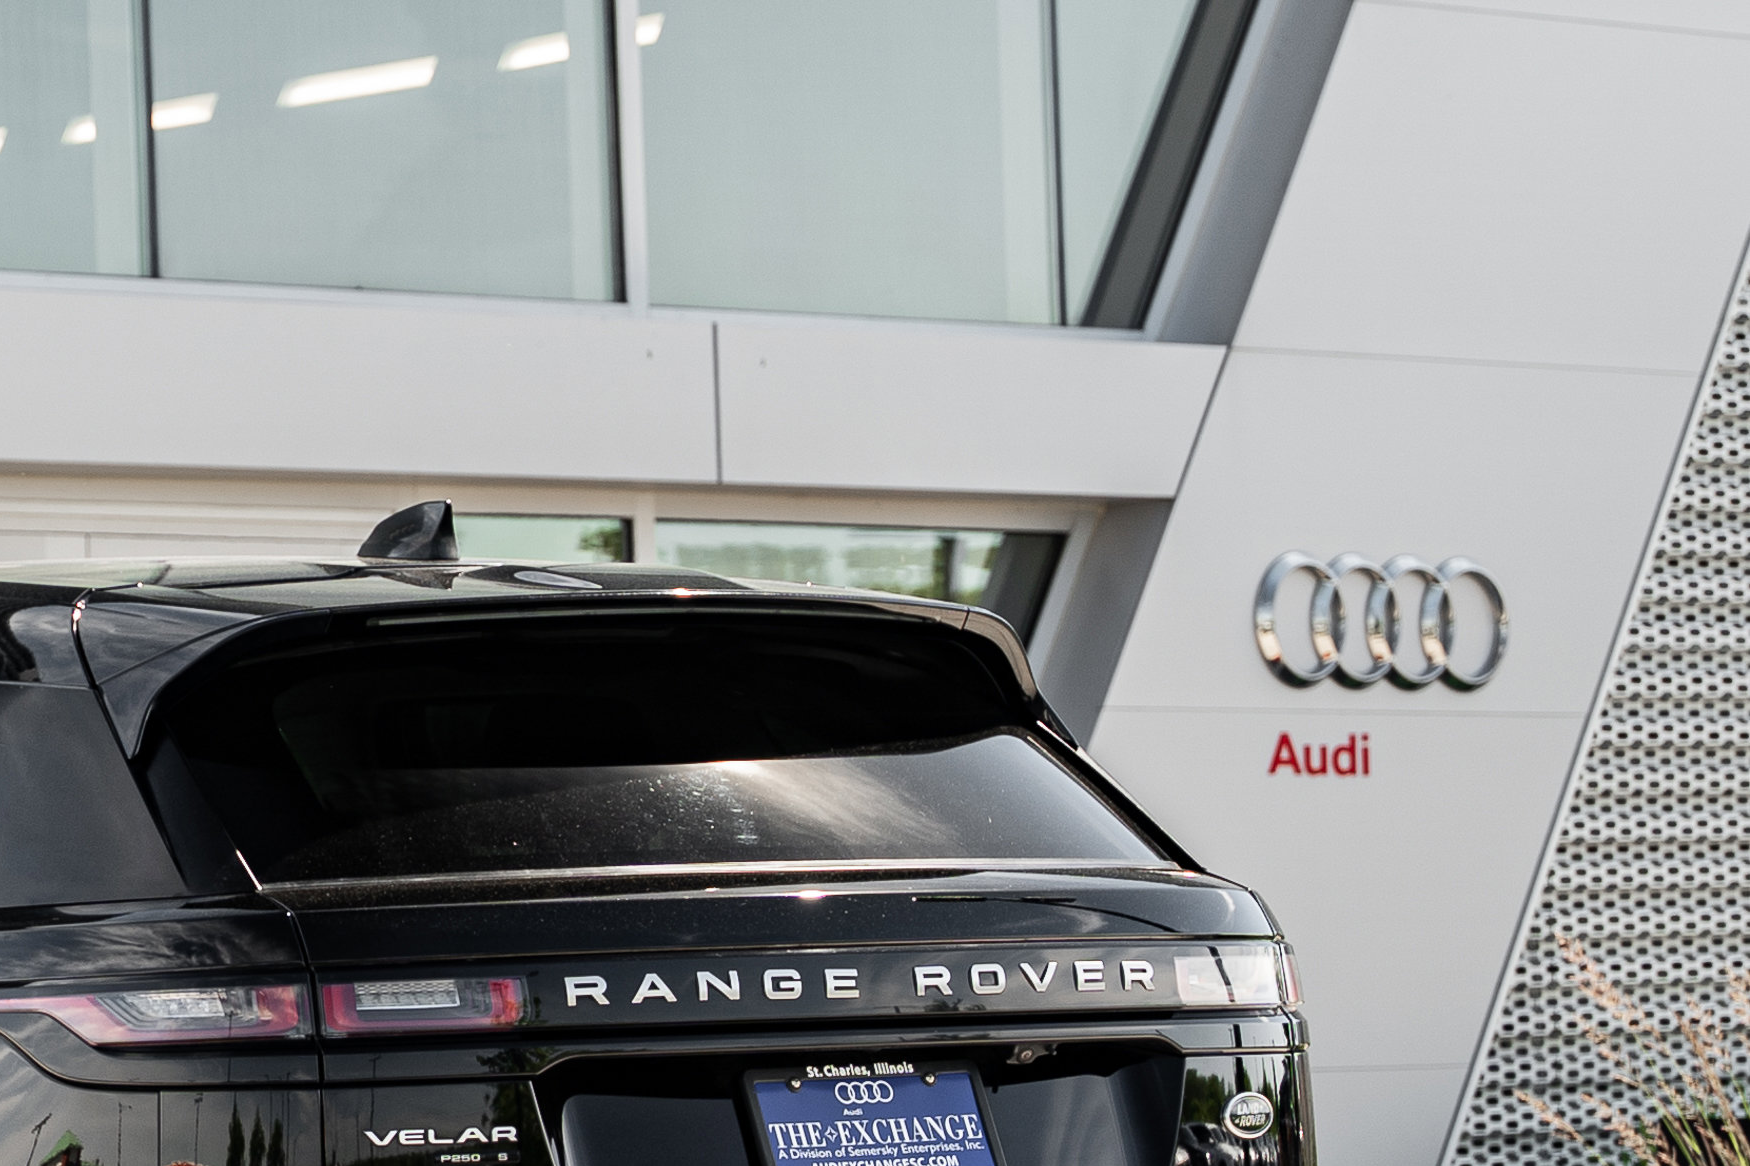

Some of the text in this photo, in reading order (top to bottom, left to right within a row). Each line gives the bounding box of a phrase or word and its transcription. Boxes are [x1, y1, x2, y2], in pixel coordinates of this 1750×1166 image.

[1268, 731, 1370, 776] Audi
[563, 959, 1156, 1007] RANGE ROVER
[806, 1061, 915, 1078] St. Charles, Illinois
[1239, 1114, 1266, 1127] ROVER
[363, 1125, 519, 1147] VELAR
[440, 1153, 482, 1164] P250
[778, 1149, 789, 1160] A
[790, 1147, 833, 1160] Division
[835, 1146, 847, 1158] of
[848, 1143, 899, 1158] Semersky
[964, 1139, 986, 1151] Inc.
